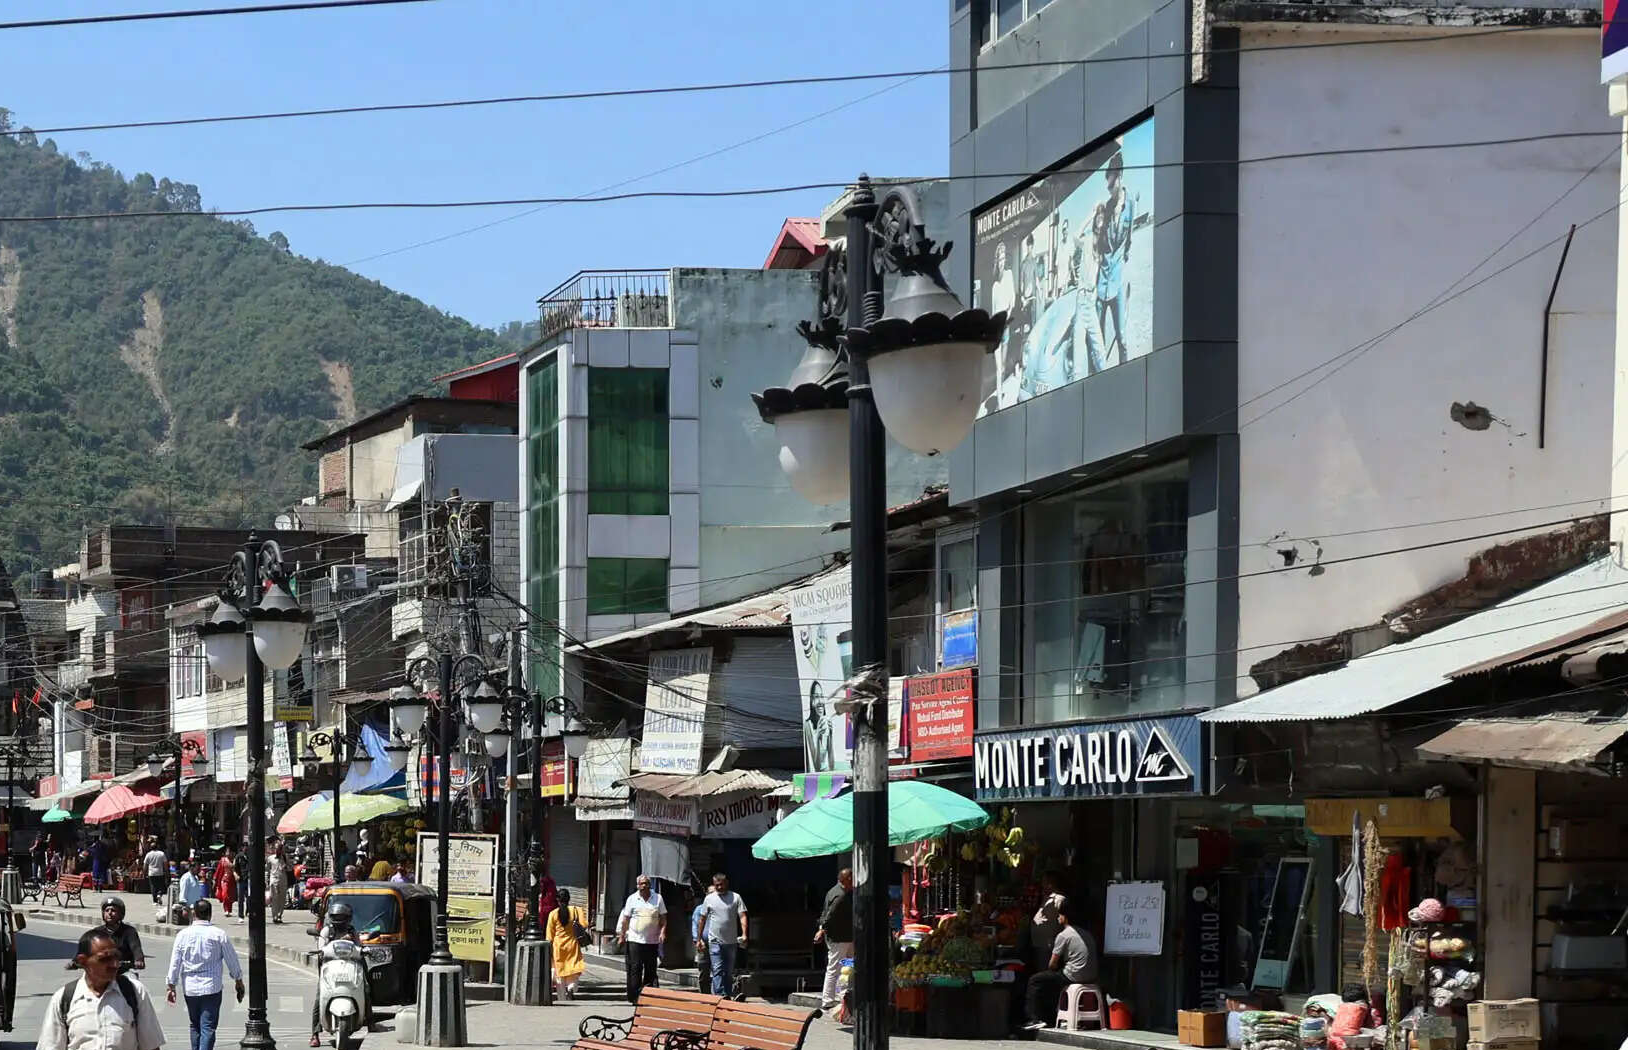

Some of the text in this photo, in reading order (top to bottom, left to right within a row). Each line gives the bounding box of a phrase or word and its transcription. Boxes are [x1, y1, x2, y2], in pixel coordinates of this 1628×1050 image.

[977, 208, 1001, 235] MONTE
[1003, 195, 1025, 222] CARLO
[974, 738, 1045, 789] MONTE
[1055, 729, 1132, 786] CARLO
[452, 927, 467, 935] NOT
[468, 928, 483, 936] SPIT
[1200, 913, 1220, 962] CARLO
[1200, 969, 1219, 1009] ONTE
